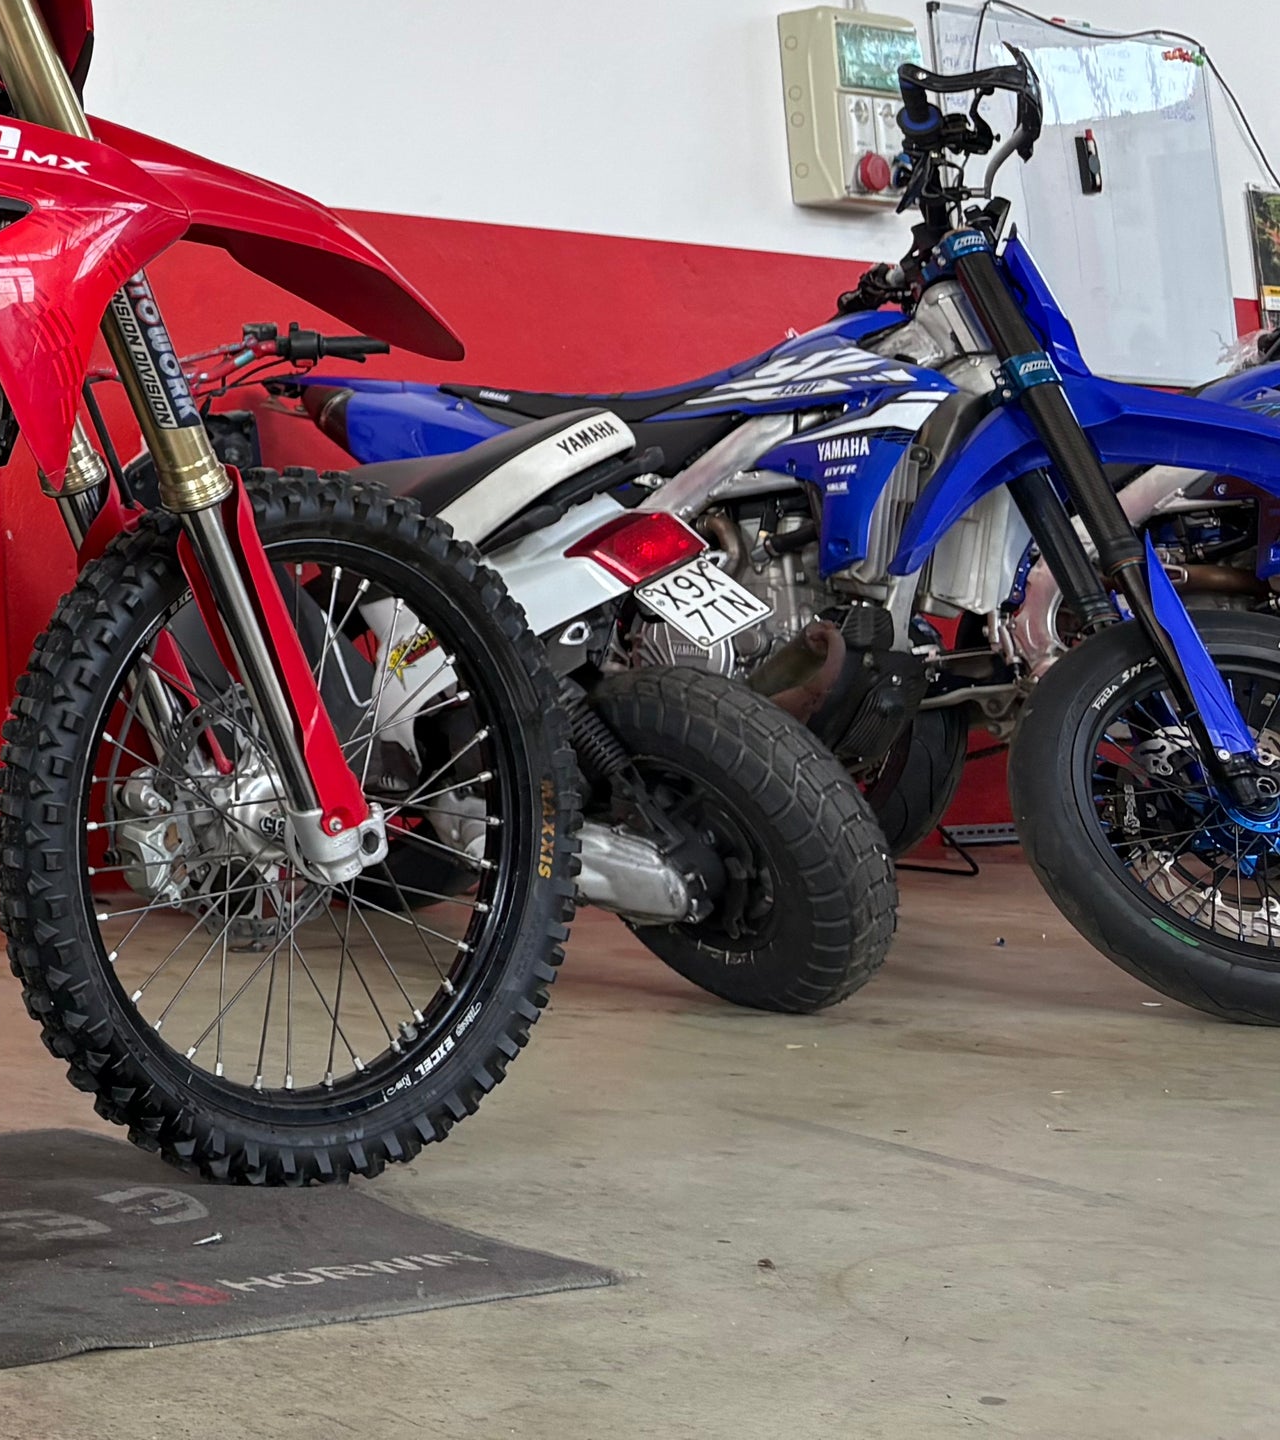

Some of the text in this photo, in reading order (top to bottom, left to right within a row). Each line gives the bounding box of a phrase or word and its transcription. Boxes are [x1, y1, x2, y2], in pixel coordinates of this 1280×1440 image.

[22, 150, 92, 176] MX
[134, 351, 174, 426] DIVISION
[556, 420, 621, 456] YAMAHA
[817, 436, 871, 461] YAMAHA
[652, 561, 726, 610] X9X
[685, 590, 759, 636] 7TN
[538, 777, 556, 879] MAXXIS
[415, 1035, 456, 1076] EXCEL
[221, 1249, 488, 1293] HORWIN
